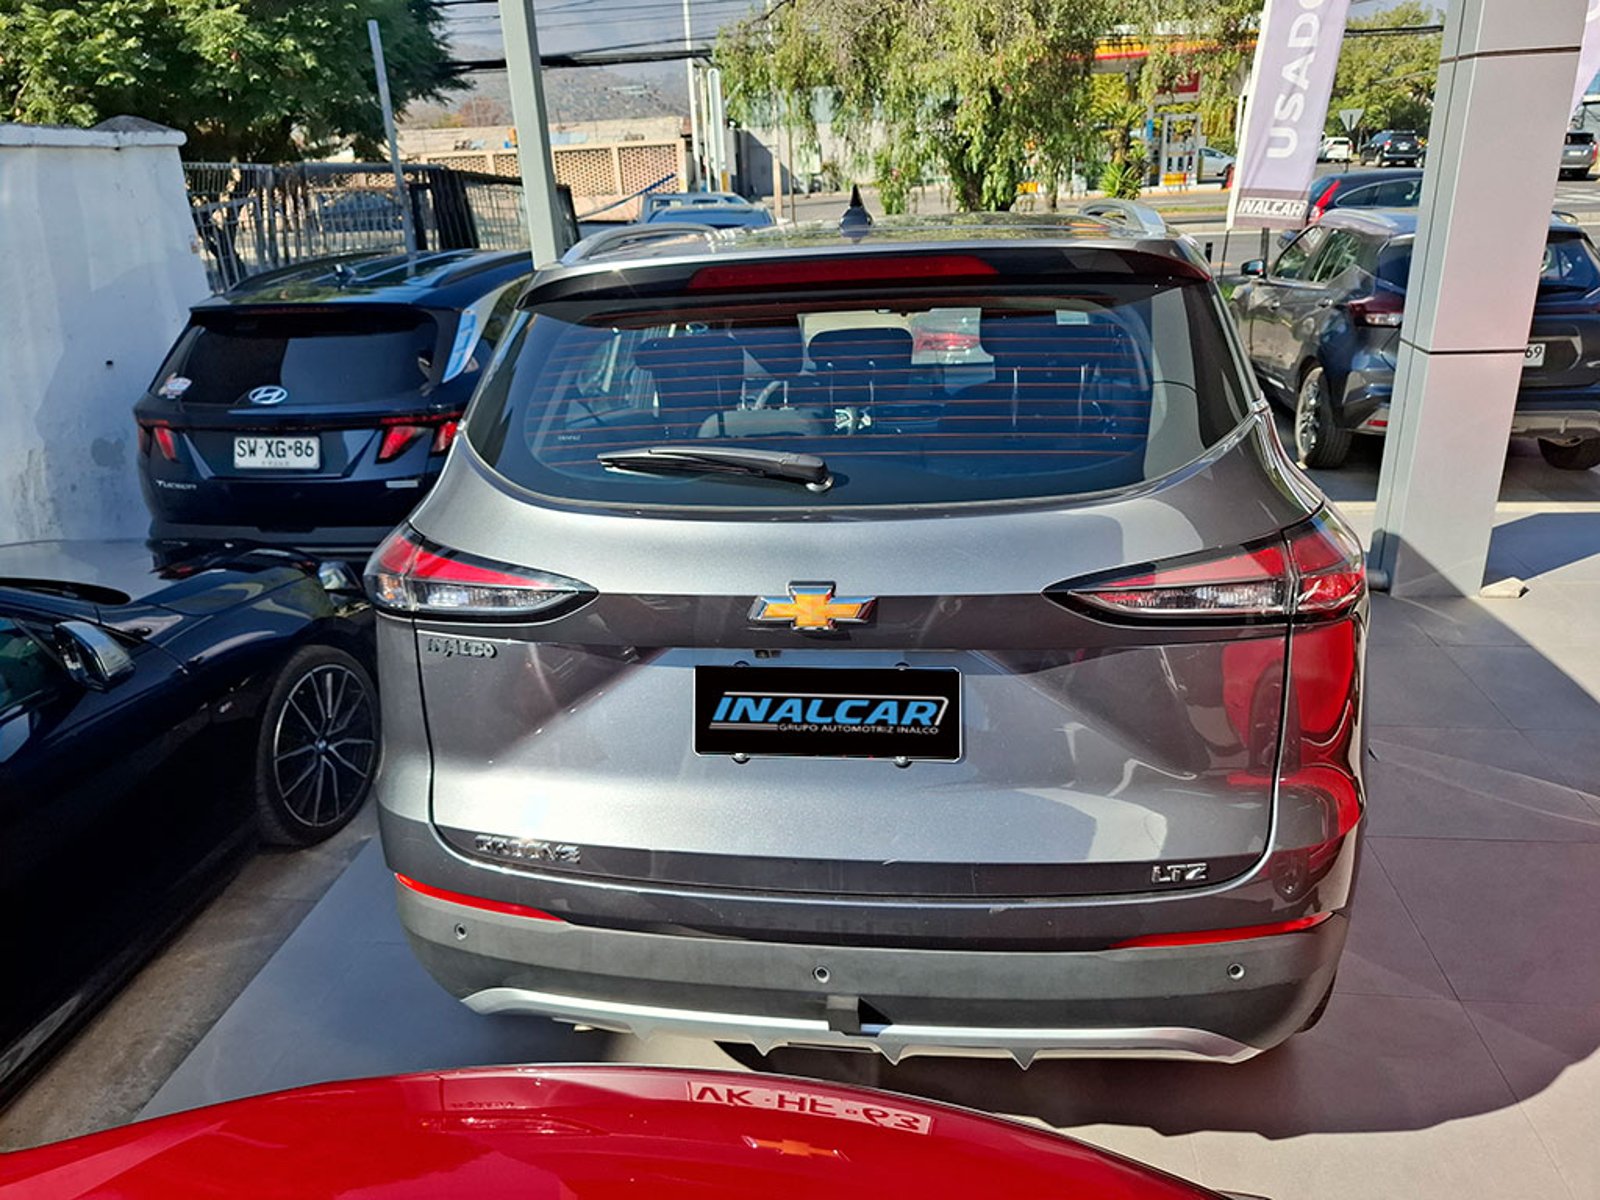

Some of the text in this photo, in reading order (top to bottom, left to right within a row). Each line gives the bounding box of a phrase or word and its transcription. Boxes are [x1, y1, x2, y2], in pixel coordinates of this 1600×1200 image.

[1266, 0, 1322, 159] USAD
[1237, 199, 1304, 216] INALCAR
[1151, 862, 1207, 883] LTZ
